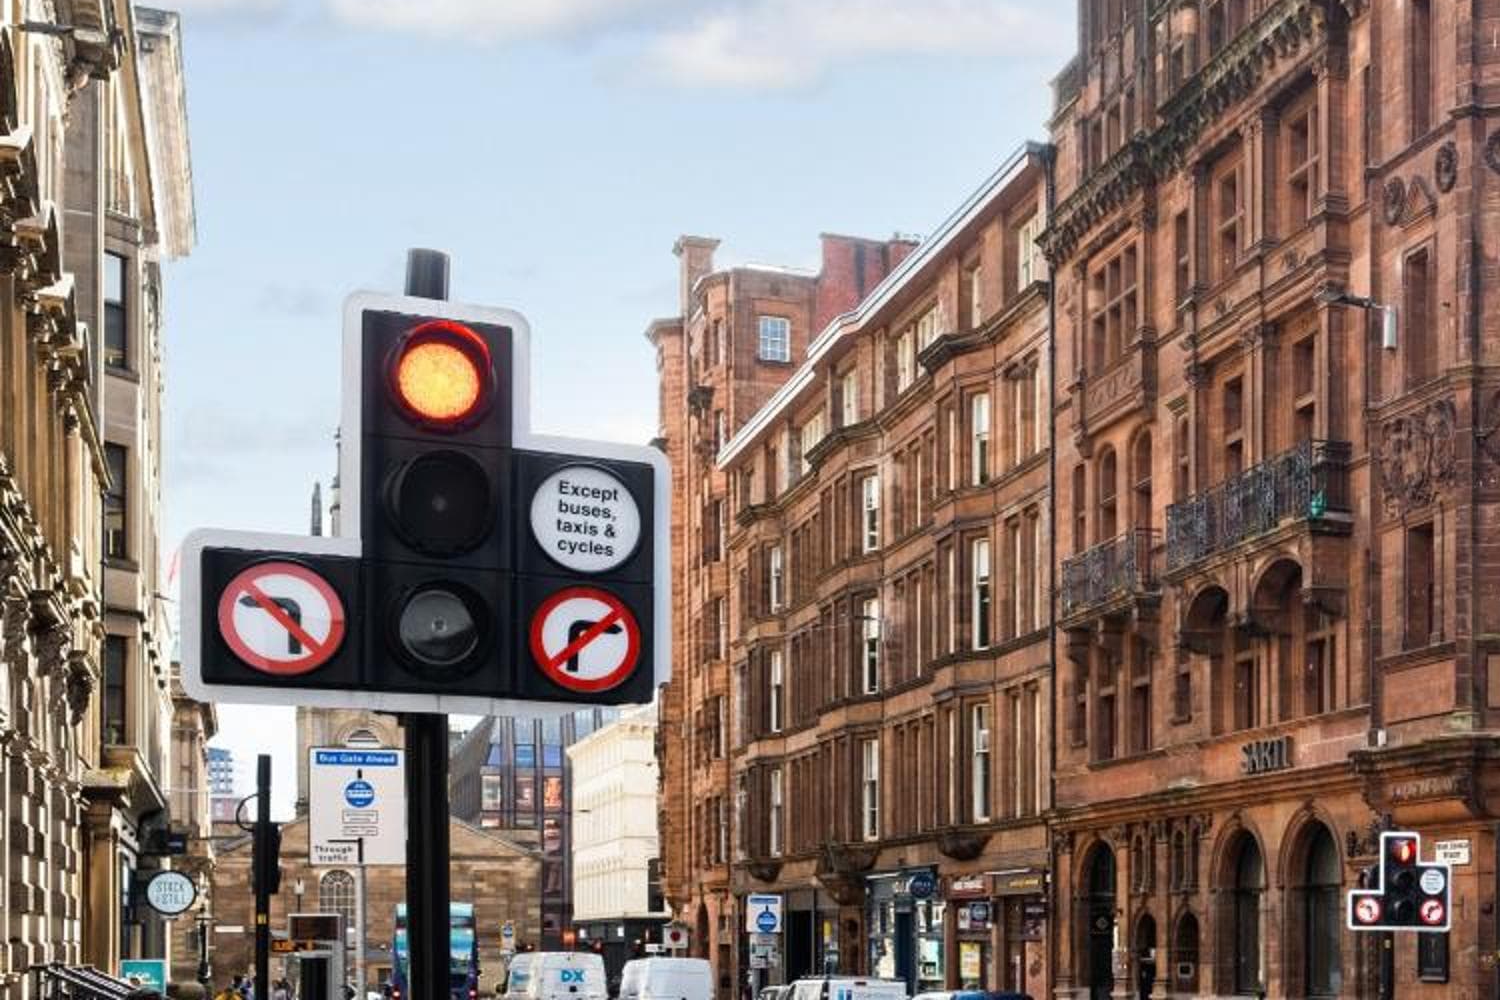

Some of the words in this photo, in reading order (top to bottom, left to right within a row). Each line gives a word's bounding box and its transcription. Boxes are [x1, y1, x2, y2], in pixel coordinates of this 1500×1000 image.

[559, 480, 618, 502] Except
[558, 500, 616, 521] buses,
[557, 519, 599, 537] taxis
[604, 523, 616, 538] &
[557, 539, 615, 557] cycles
[560, 969, 585, 983] DX
